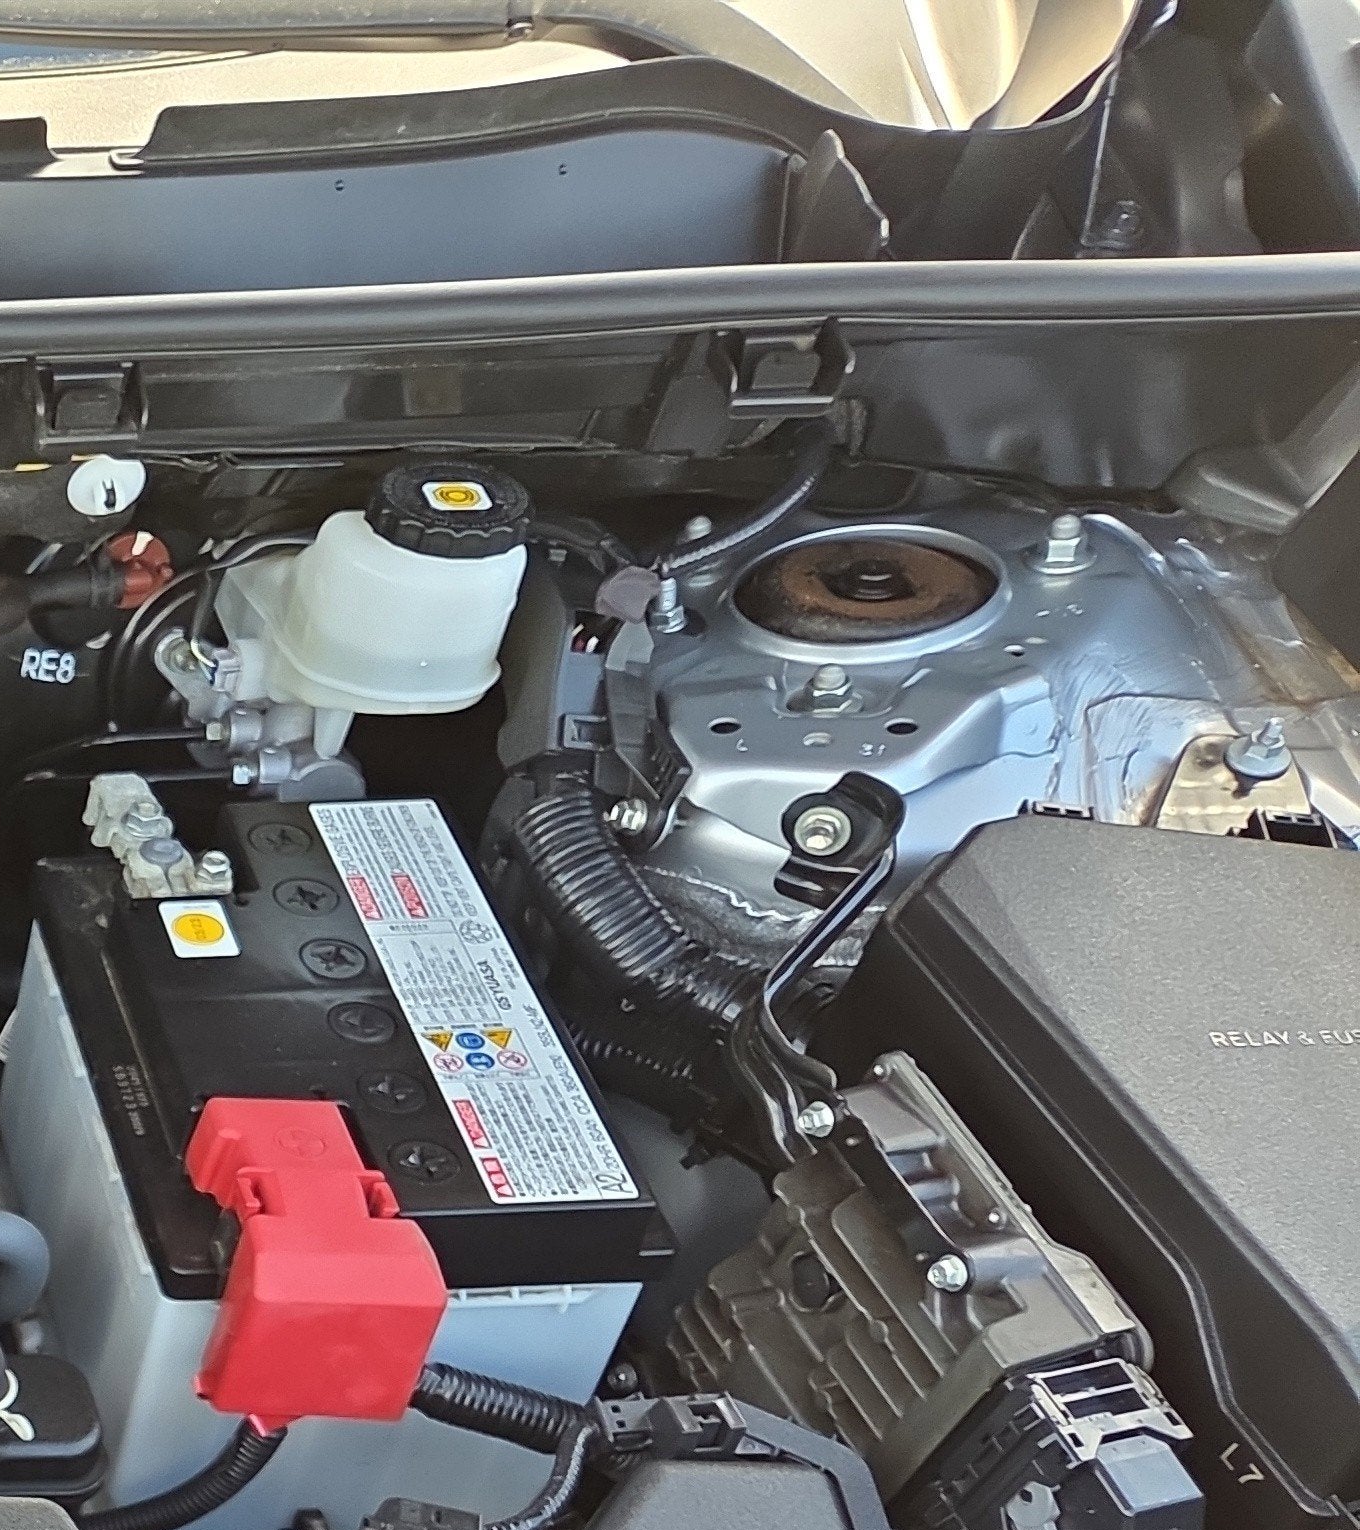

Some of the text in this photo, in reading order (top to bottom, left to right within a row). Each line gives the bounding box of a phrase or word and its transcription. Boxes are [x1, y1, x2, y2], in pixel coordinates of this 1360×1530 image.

[20, 648, 76, 684] RE8
[1208, 1030, 1290, 1048] RELAY
[1297, 1030, 1316, 1046] &
[592, 1172, 634, 1194] A2
